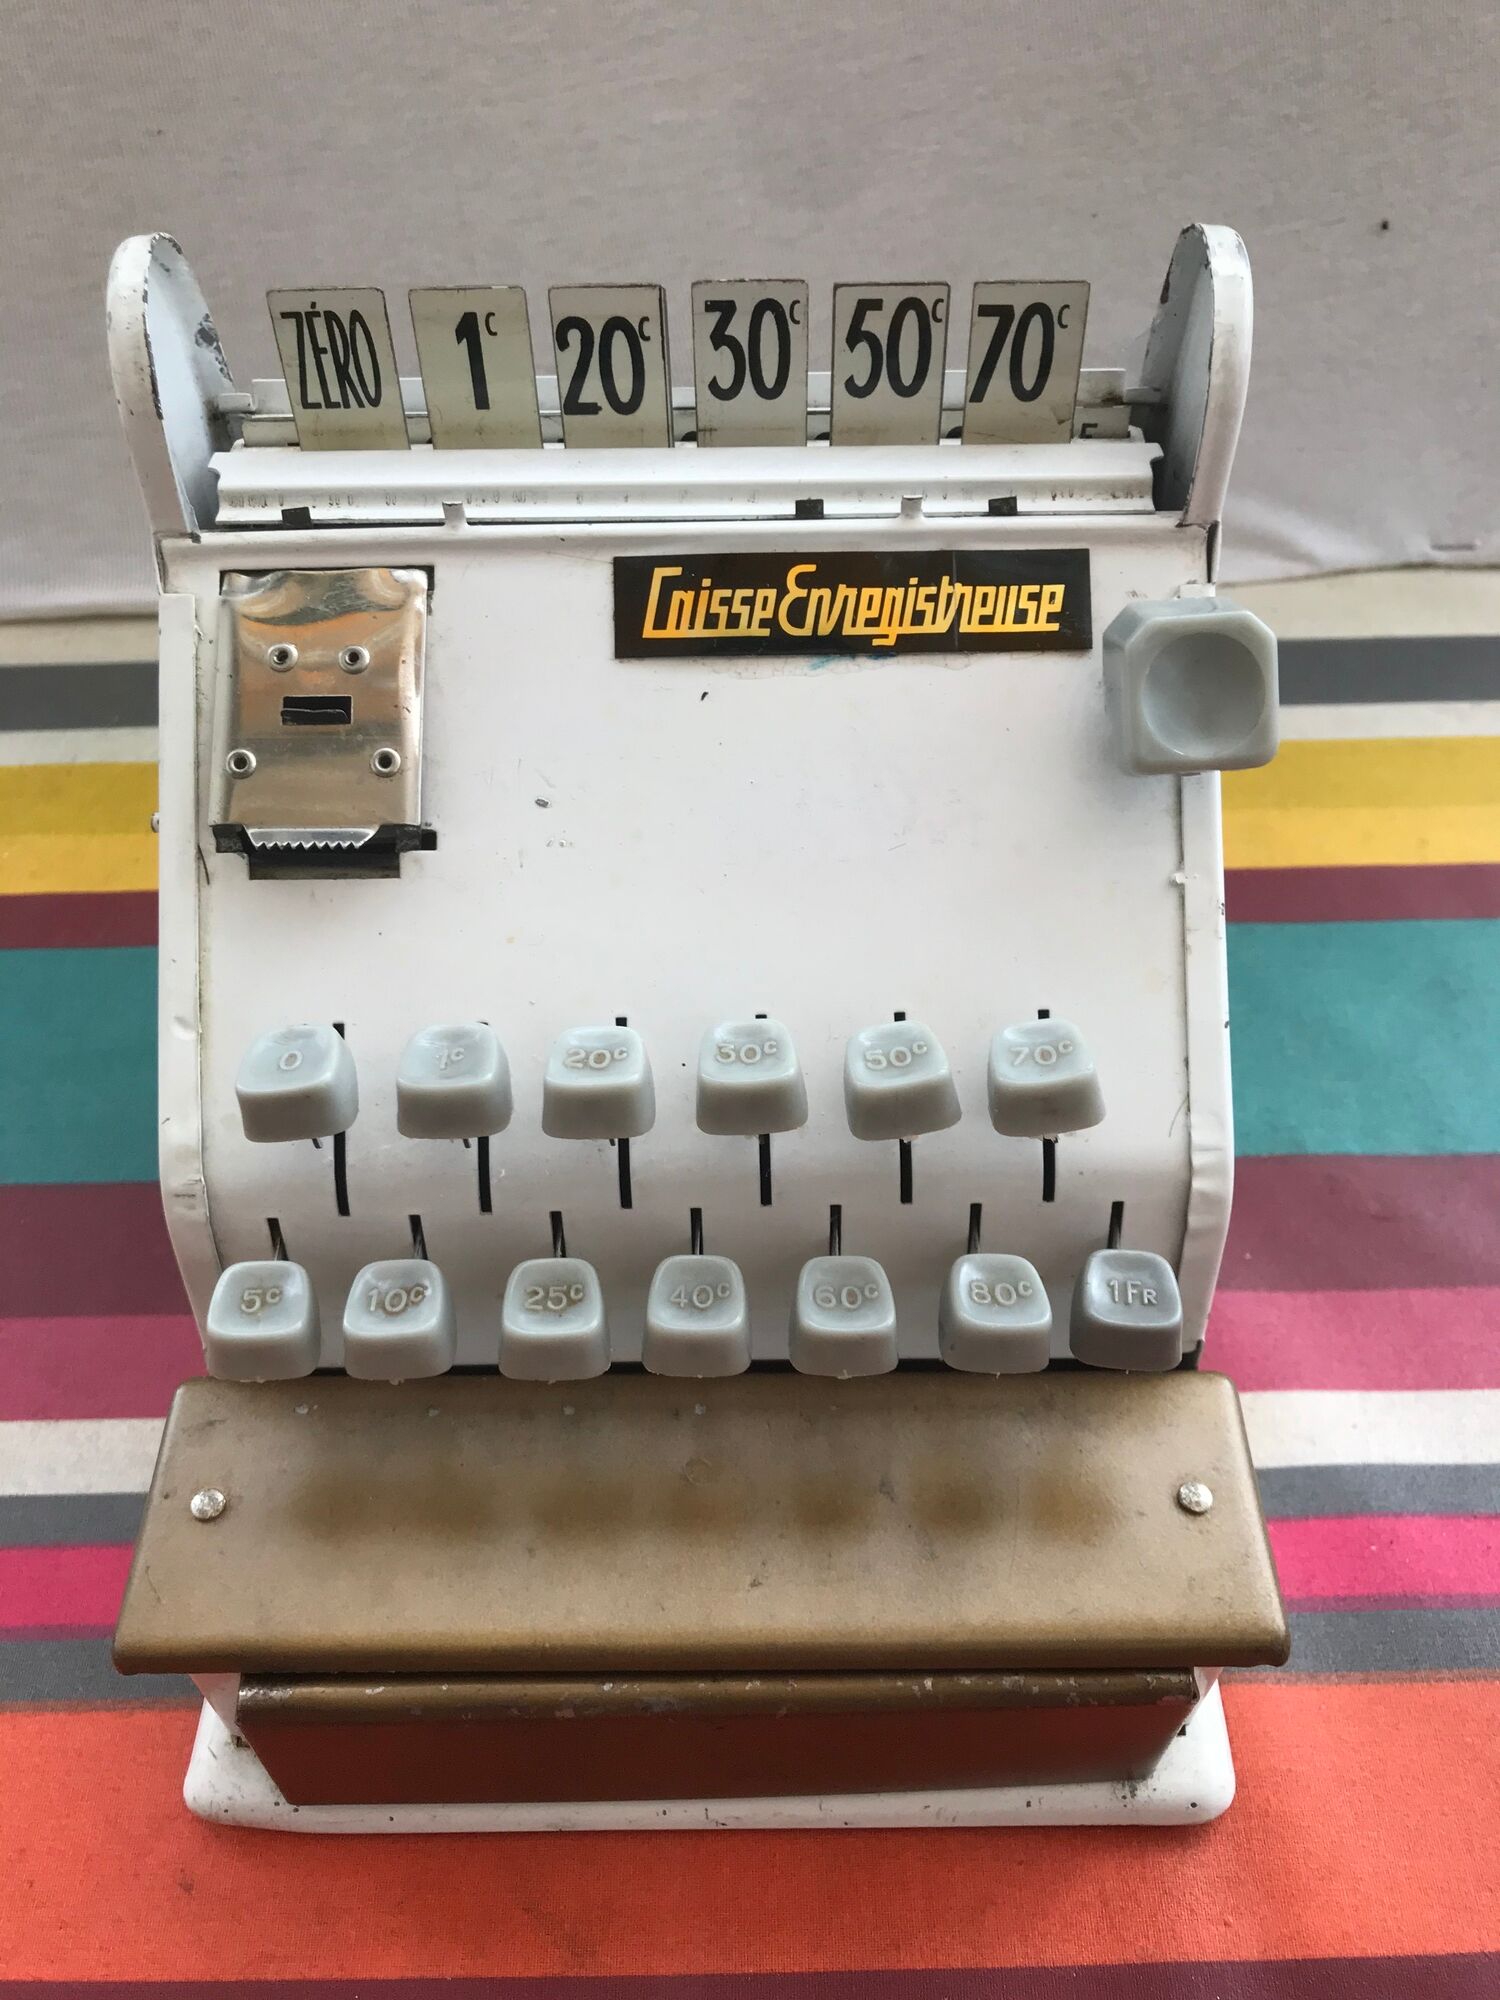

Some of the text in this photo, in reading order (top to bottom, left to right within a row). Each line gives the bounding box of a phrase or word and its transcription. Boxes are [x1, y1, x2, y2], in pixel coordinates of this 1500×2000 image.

[280, 302, 382, 410] ZÉRO
[642, 564, 1066, 647] Caisse Enregistreuse
